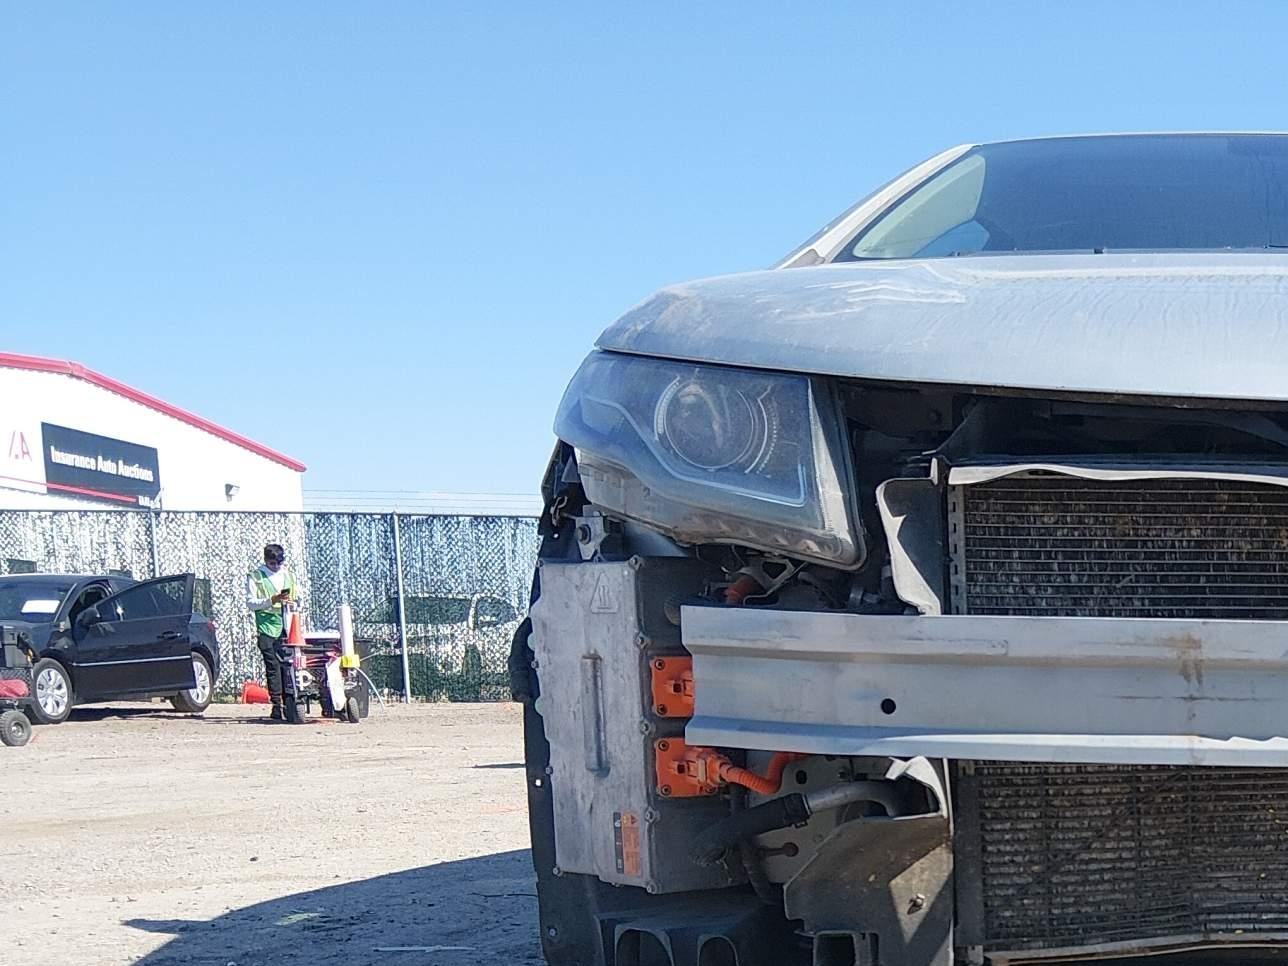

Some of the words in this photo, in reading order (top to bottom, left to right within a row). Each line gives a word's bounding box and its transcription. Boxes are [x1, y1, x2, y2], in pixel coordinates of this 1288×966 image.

[50, 445, 96, 471] Insurance
[97, 455, 117, 475] Auto
[117, 459, 154, 483] Auctions
